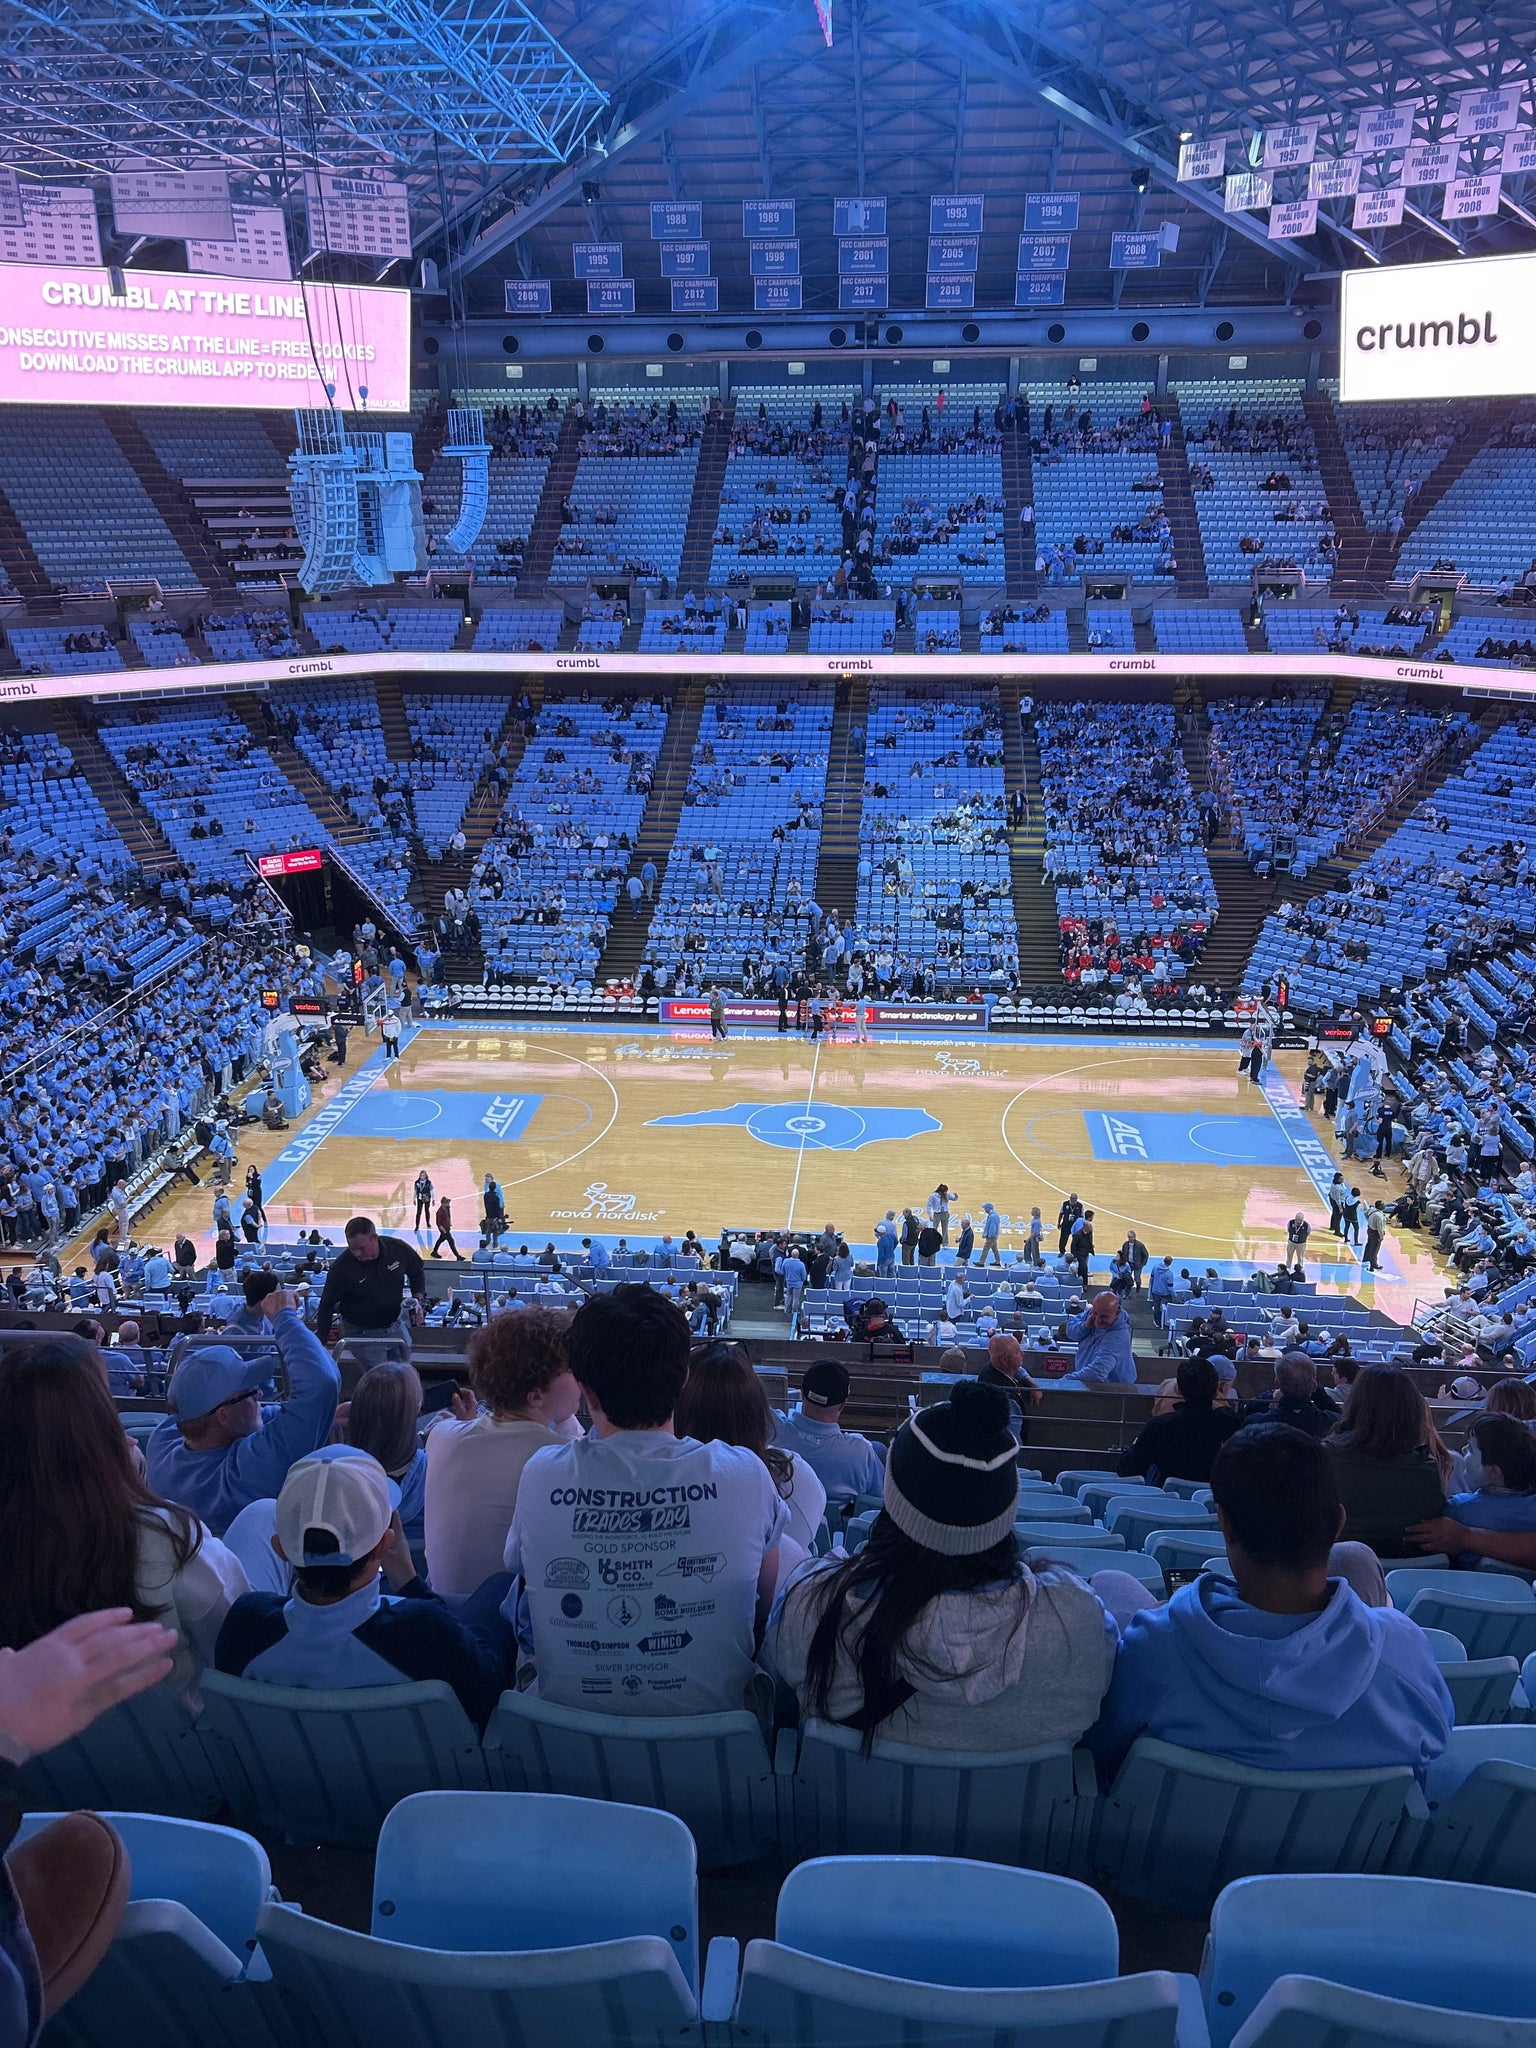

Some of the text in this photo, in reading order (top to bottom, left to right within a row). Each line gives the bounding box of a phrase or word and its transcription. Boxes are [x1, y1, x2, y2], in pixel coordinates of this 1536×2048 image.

[1378, 110, 1395, 120] NCAA
[1468, 106, 1488, 116] FINAL
[1367, 119, 1404, 132] FINAL FOUR
[1273, 136, 1308, 149] FINAL FOUR
[1374, 133, 1394, 146] 1967
[1280, 150, 1299, 162] 1957
[1422, 147, 1440, 156] NCAA
[1412, 155, 1449, 167] FINAL FOUR
[1192, 164, 1209, 176] 1946
[1419, 168, 1439, 180] 1991
[355, 182, 375, 194] ELITE
[1464, 178, 1482, 188] NCAA
[1372, 192, 1388, 200] NCAA
[1454, 186, 1490, 199] FINAL FOUR
[1042, 195, 1077, 203] CHAMPIONS
[666, 204, 699, 212] CHAMPIONS
[1286, 203, 1301, 212] NCAA
[1362, 200, 1395, 211] FINAL FOUR
[1458, 201, 1481, 213] 2008
[946, 208, 967, 218] 1993
[1041, 206, 1062, 216] 1994
[759, 212, 779, 222] 1989
[1278, 213, 1292, 222] FINAL
[1367, 212, 1388, 224] 2005
[1282, 223, 1302, 234] 2000
[854, 240, 887, 248] CHAMPIONS
[943, 238, 976, 246] CHAMPIONS
[942, 249, 963, 258] 2005
[1033, 247, 1055, 256] 2007
[1125, 245, 1146, 254] 2008
[588, 255, 608, 265] 1995
[676, 253, 694, 263] 1997
[765, 252, 784, 261] 1998
[854, 250, 873, 260] 2001
[855, 287, 873, 295] 2017
[940, 286, 960, 295] 2019
[1030, 283, 1050, 292] 2024
[518, 292, 538, 300] 2009
[602, 291, 621, 300] 2011
[685, 290, 704, 298] 2012
[42, 281, 305, 318] CRUMBL AT THE LINE
[1356, 310, 1497, 350] crumbl
[108, 332, 169, 351] MISSES
[171, 336, 190, 352] AT
[192, 336, 224, 353] THE
[311, 342, 375, 361] COOKIES
[20, 352, 337, 380] DOWNLOAD THE CRUMBL APP TO REDEEM
[289, 661, 333, 674] crumbl
[557, 657, 600, 668] crumbl
[828, 658, 873, 670] crumbl
[1110, 659, 1156, 670] crumbl
[1397, 666, 1444, 680] crumbl
[724, 1008, 753, 1016] Smarter
[912, 1013, 954, 1021] technology
[1265, 1085, 1303, 1119] TAR
[278, 1067, 384, 1163] CAROLINA
[481, 1096, 519, 1134] ACC
[1110, 1117, 1149, 1158] ACC
[550, 1210, 658, 1220] novo nordisk
[550, 1482, 718, 1508] CONSTRUCTION
[650, 1506, 688, 1531] DAY
[584, 1540, 676, 1554] GOLD SPONSOR
[615, 1560, 652, 1570] SMITH
[623, 1572, 644, 1581] CO.
[681, 1603, 715, 1614] BUILDERS
[567, 1640, 591, 1648] THOMAS
[648, 1635, 682, 1650] WIMCO
[596, 1663, 669, 1672] SILVER SPONSOR
